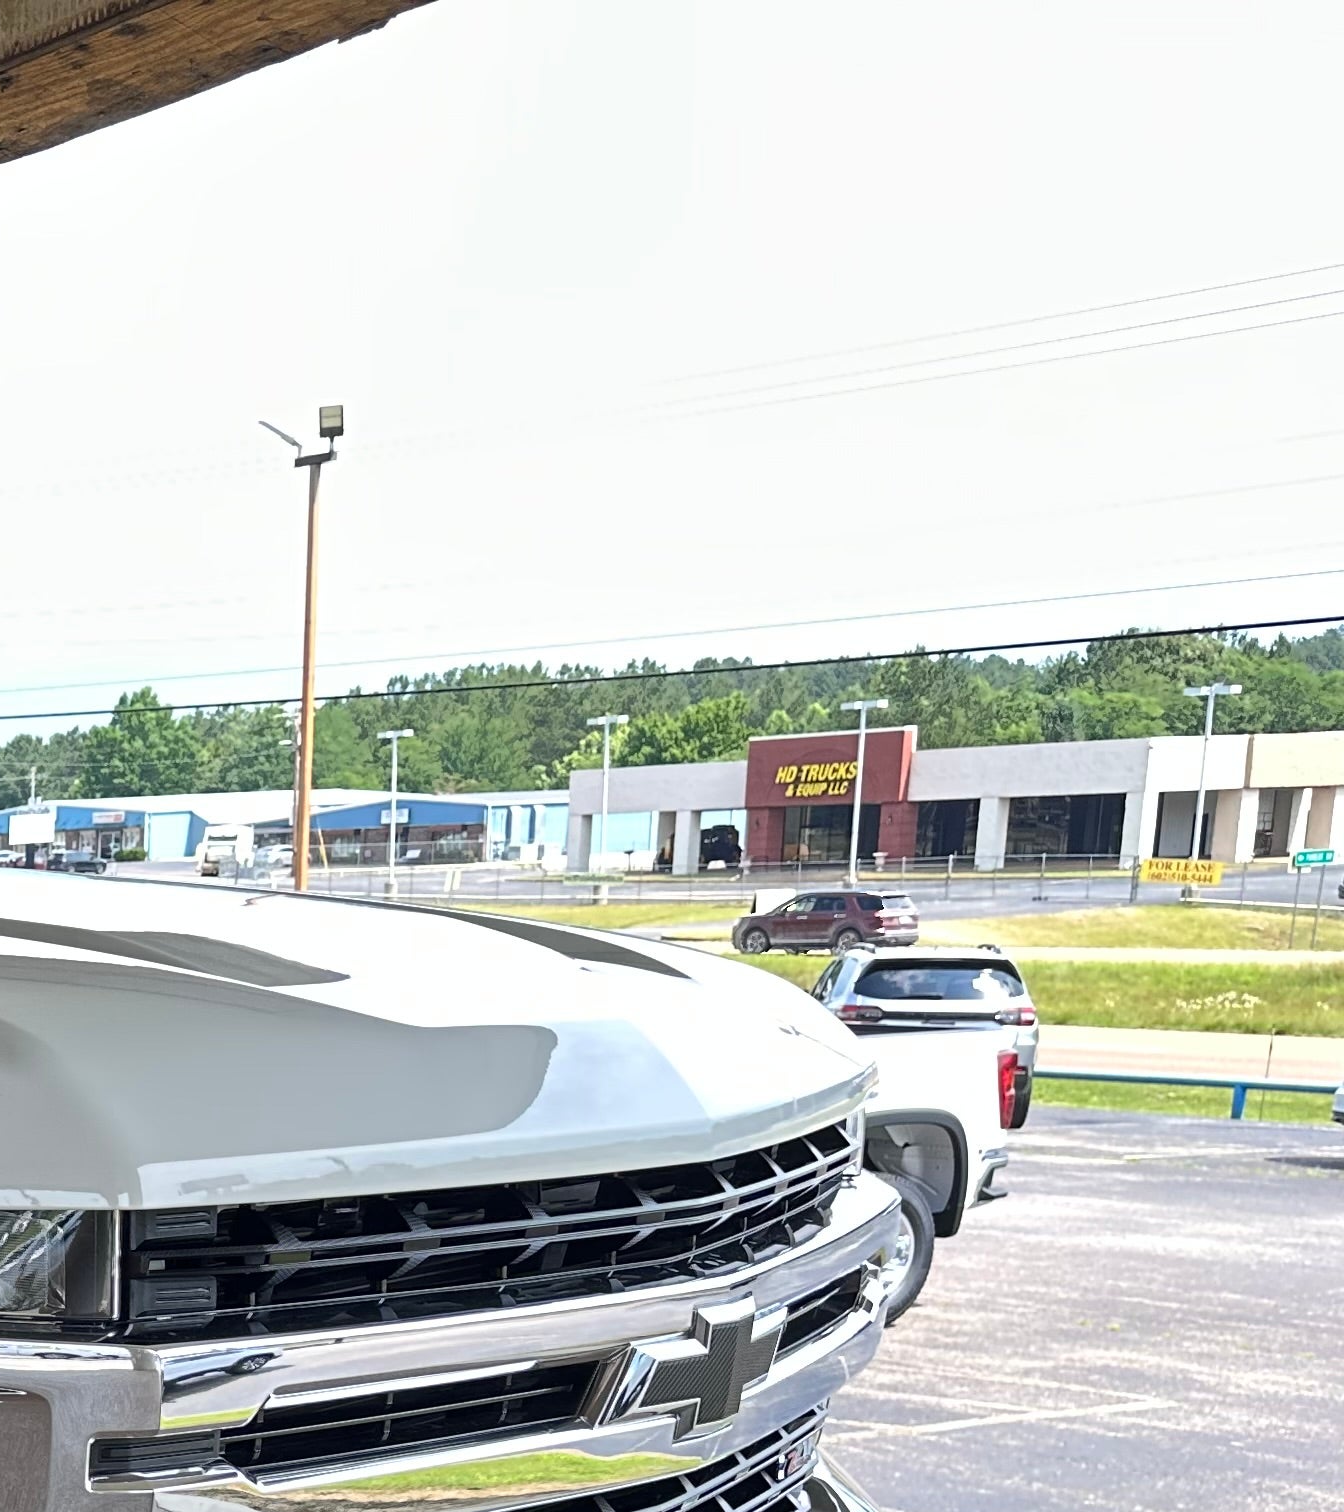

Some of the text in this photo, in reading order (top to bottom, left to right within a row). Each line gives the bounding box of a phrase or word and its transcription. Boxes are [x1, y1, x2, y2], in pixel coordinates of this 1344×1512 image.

[775, 761, 858, 784] HD TRUCKS
[785, 781, 849, 797] & EQUIP LLC
[1149, 860, 1216, 873] FOR LEASE
